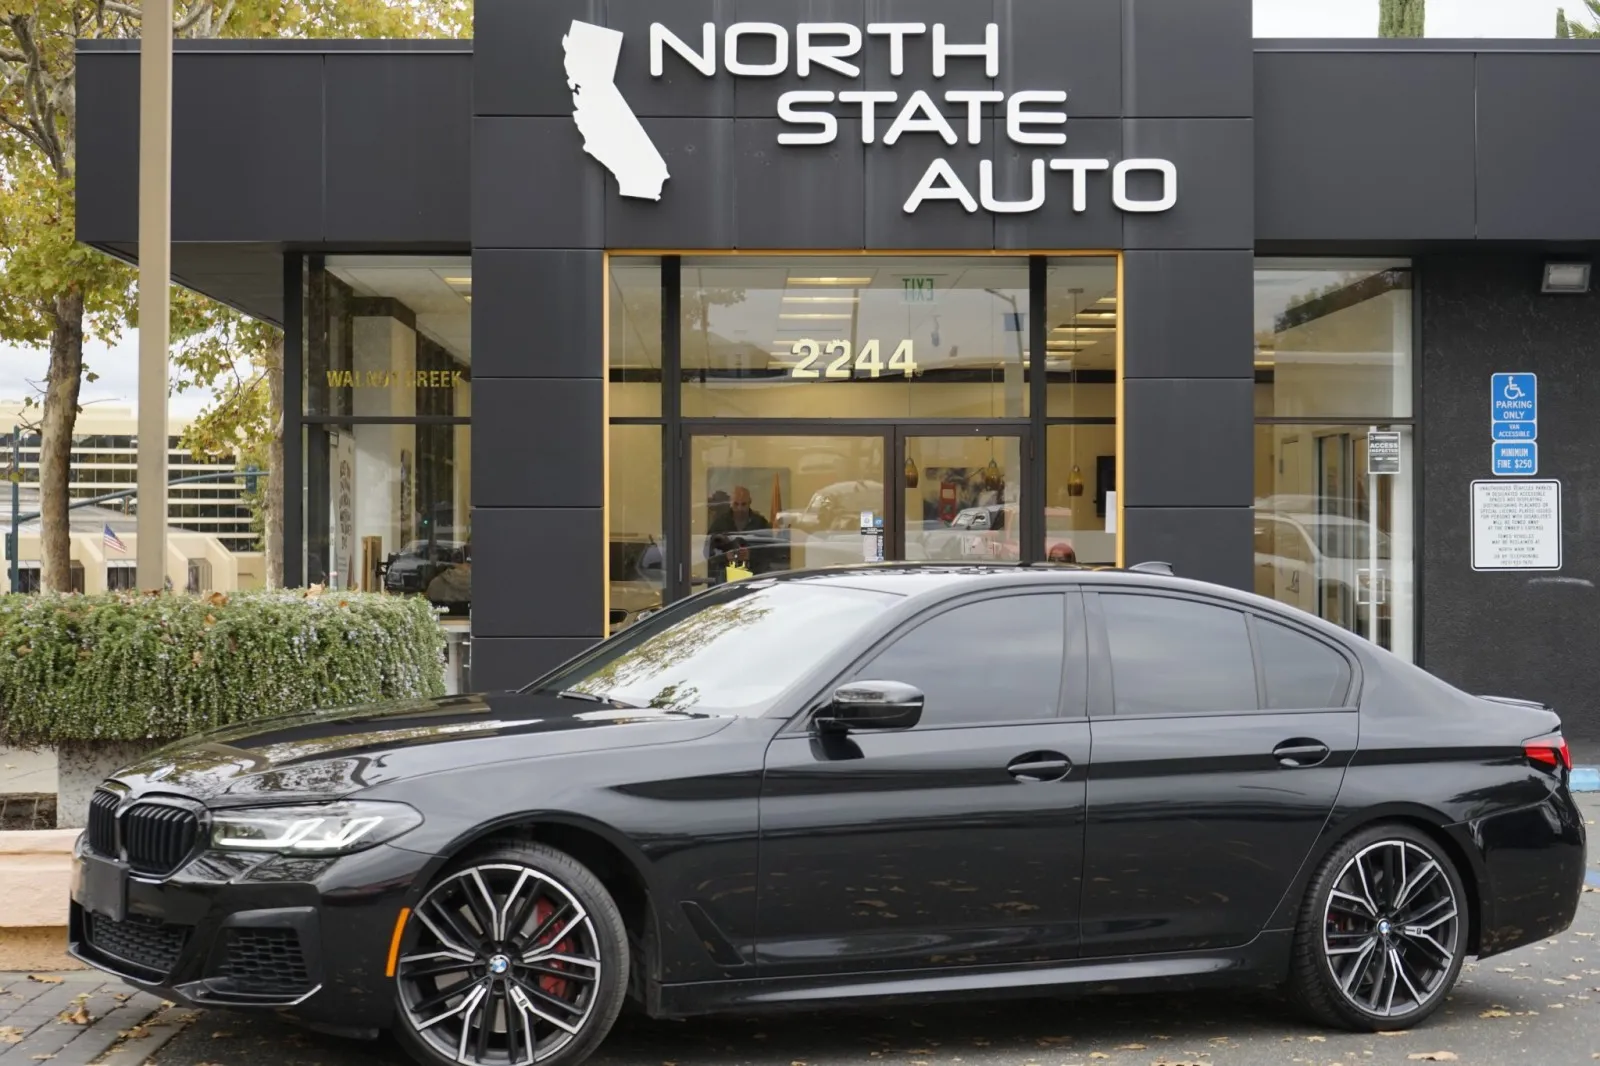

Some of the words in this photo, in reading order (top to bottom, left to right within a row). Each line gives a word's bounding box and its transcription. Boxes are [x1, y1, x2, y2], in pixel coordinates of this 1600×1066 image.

[649, 22, 999, 78] NORTH
[777, 90, 1067, 145] STATE
[903, 158, 1178, 213] AUTO
[791, 338, 918, 378] 2244
[1496, 400, 1532, 409] PARKING
[1503, 411, 1525, 419] ONLY
[1498, 460, 1512, 469] FINE
[1514, 460, 1532, 469] $250
[1500, 448, 1528, 457] MINIMUM
